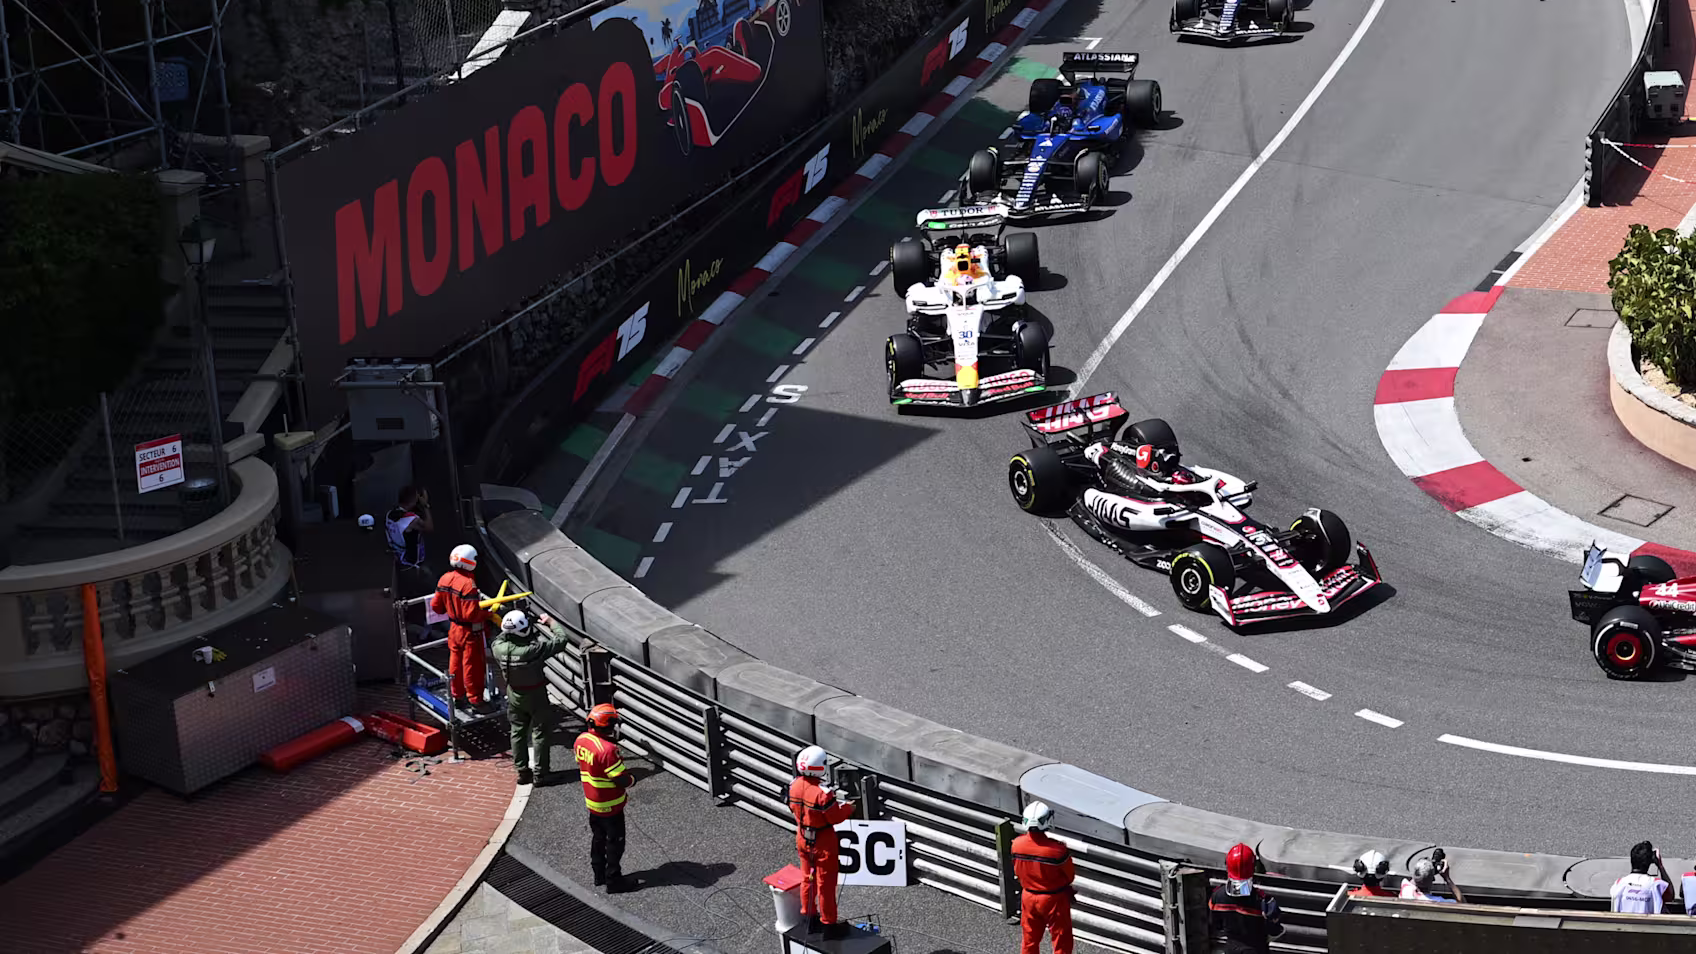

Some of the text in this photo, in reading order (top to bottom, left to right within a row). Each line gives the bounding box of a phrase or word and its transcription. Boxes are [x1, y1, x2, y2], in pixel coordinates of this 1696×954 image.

[1074, 53, 1131, 62] ATLASSIAN
[335, 61, 638, 345] MONACO
[941, 206, 985, 217] TUDOR
[677, 257, 724, 318] Monaco
[958, 330, 973, 339] 30
[988, 371, 1031, 387] HUGO
[138, 444, 177, 462] SECTEUR 6
[141, 457, 180, 476] INTERVENTION
[158, 473, 164, 482] 6
[1655, 582, 1679, 597] 44
[1658, 599, 1696, 612] UniCredit
[837, 829, 896, 876] SC
